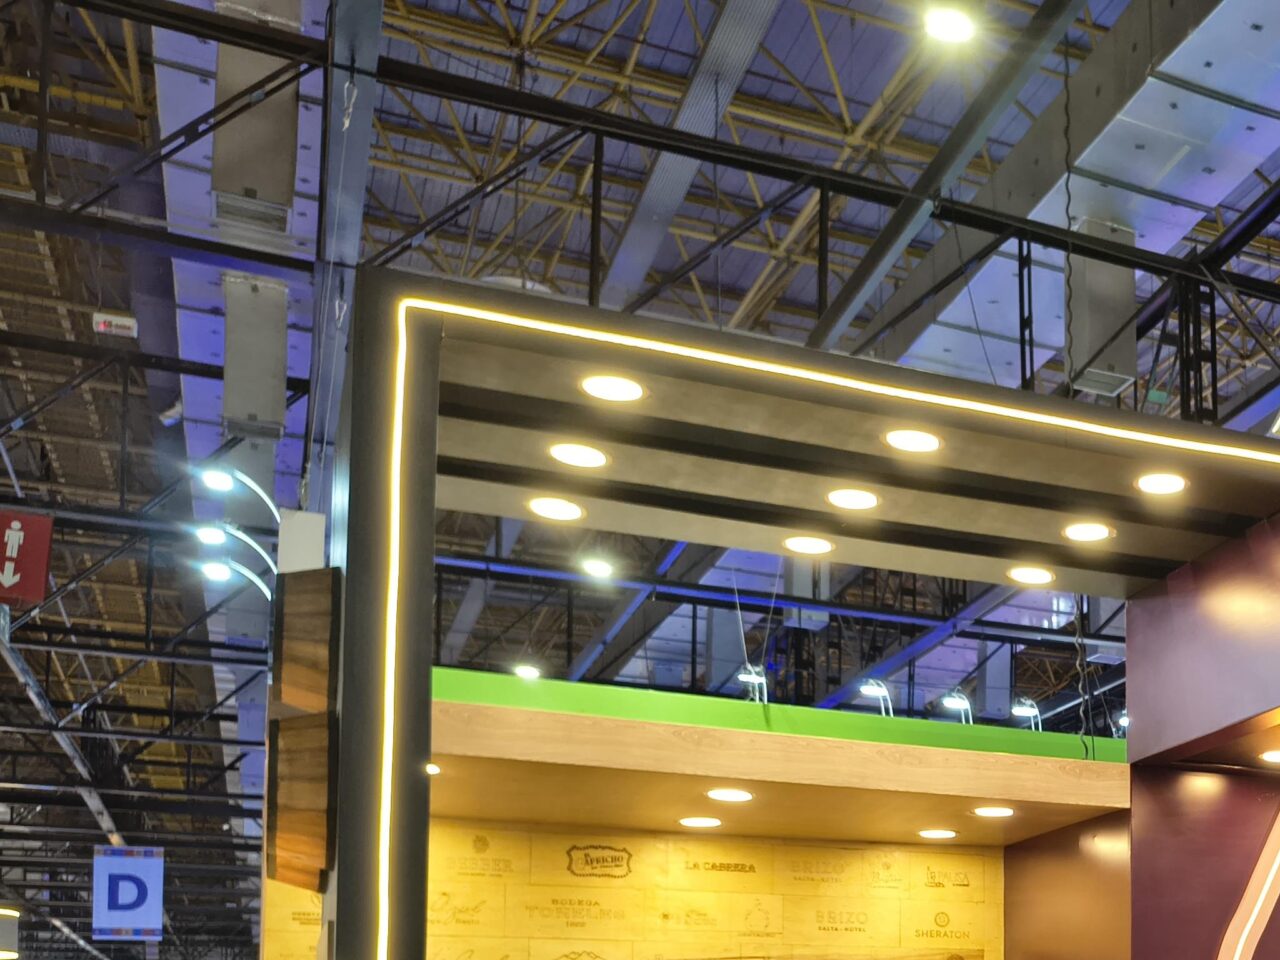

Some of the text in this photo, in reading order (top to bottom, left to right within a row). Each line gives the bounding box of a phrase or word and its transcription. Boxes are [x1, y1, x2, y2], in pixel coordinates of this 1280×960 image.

[107, 873, 148, 912] D
[815, 910, 869, 925] BRIZO
[914, 929, 971, 940] SHERATON
